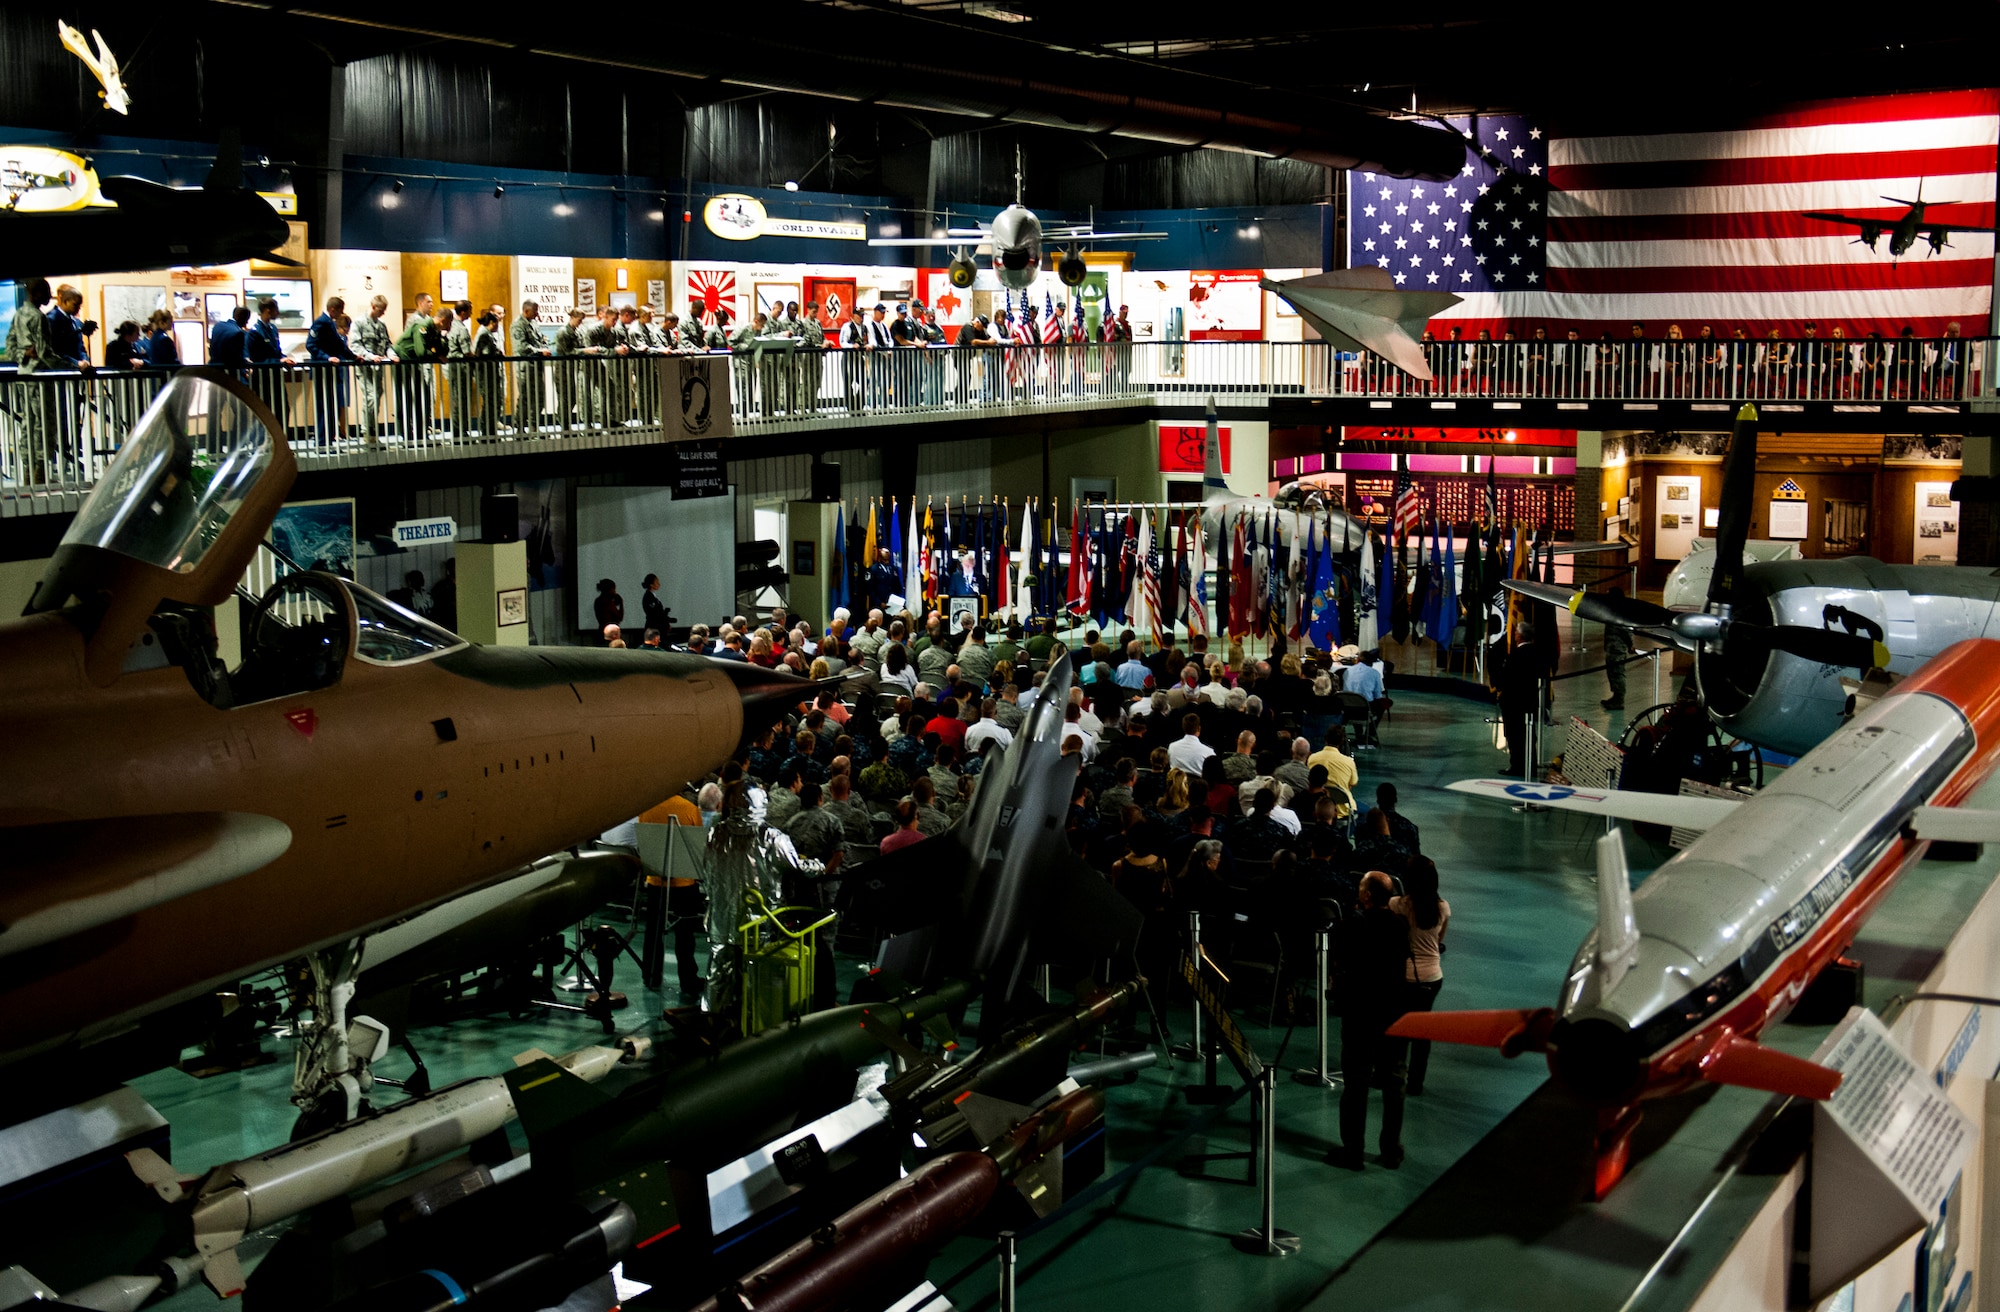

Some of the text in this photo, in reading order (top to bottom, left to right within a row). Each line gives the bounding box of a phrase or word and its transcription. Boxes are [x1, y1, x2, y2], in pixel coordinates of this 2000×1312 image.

[772, 224, 814, 233] WORLD
[819, 226, 847, 234] WAR
[523, 285, 570, 293] AIR POWER
[539, 295, 557, 303] AND
[538, 305, 560, 313] ORLD
[690, 451, 703, 460] GAVE
[694, 478, 708, 488] GAVE
[398, 522, 452, 541] THEATER
[1769, 898, 1819, 951] GENERAL
[1811, 863, 1852, 913] DYNAMICS
